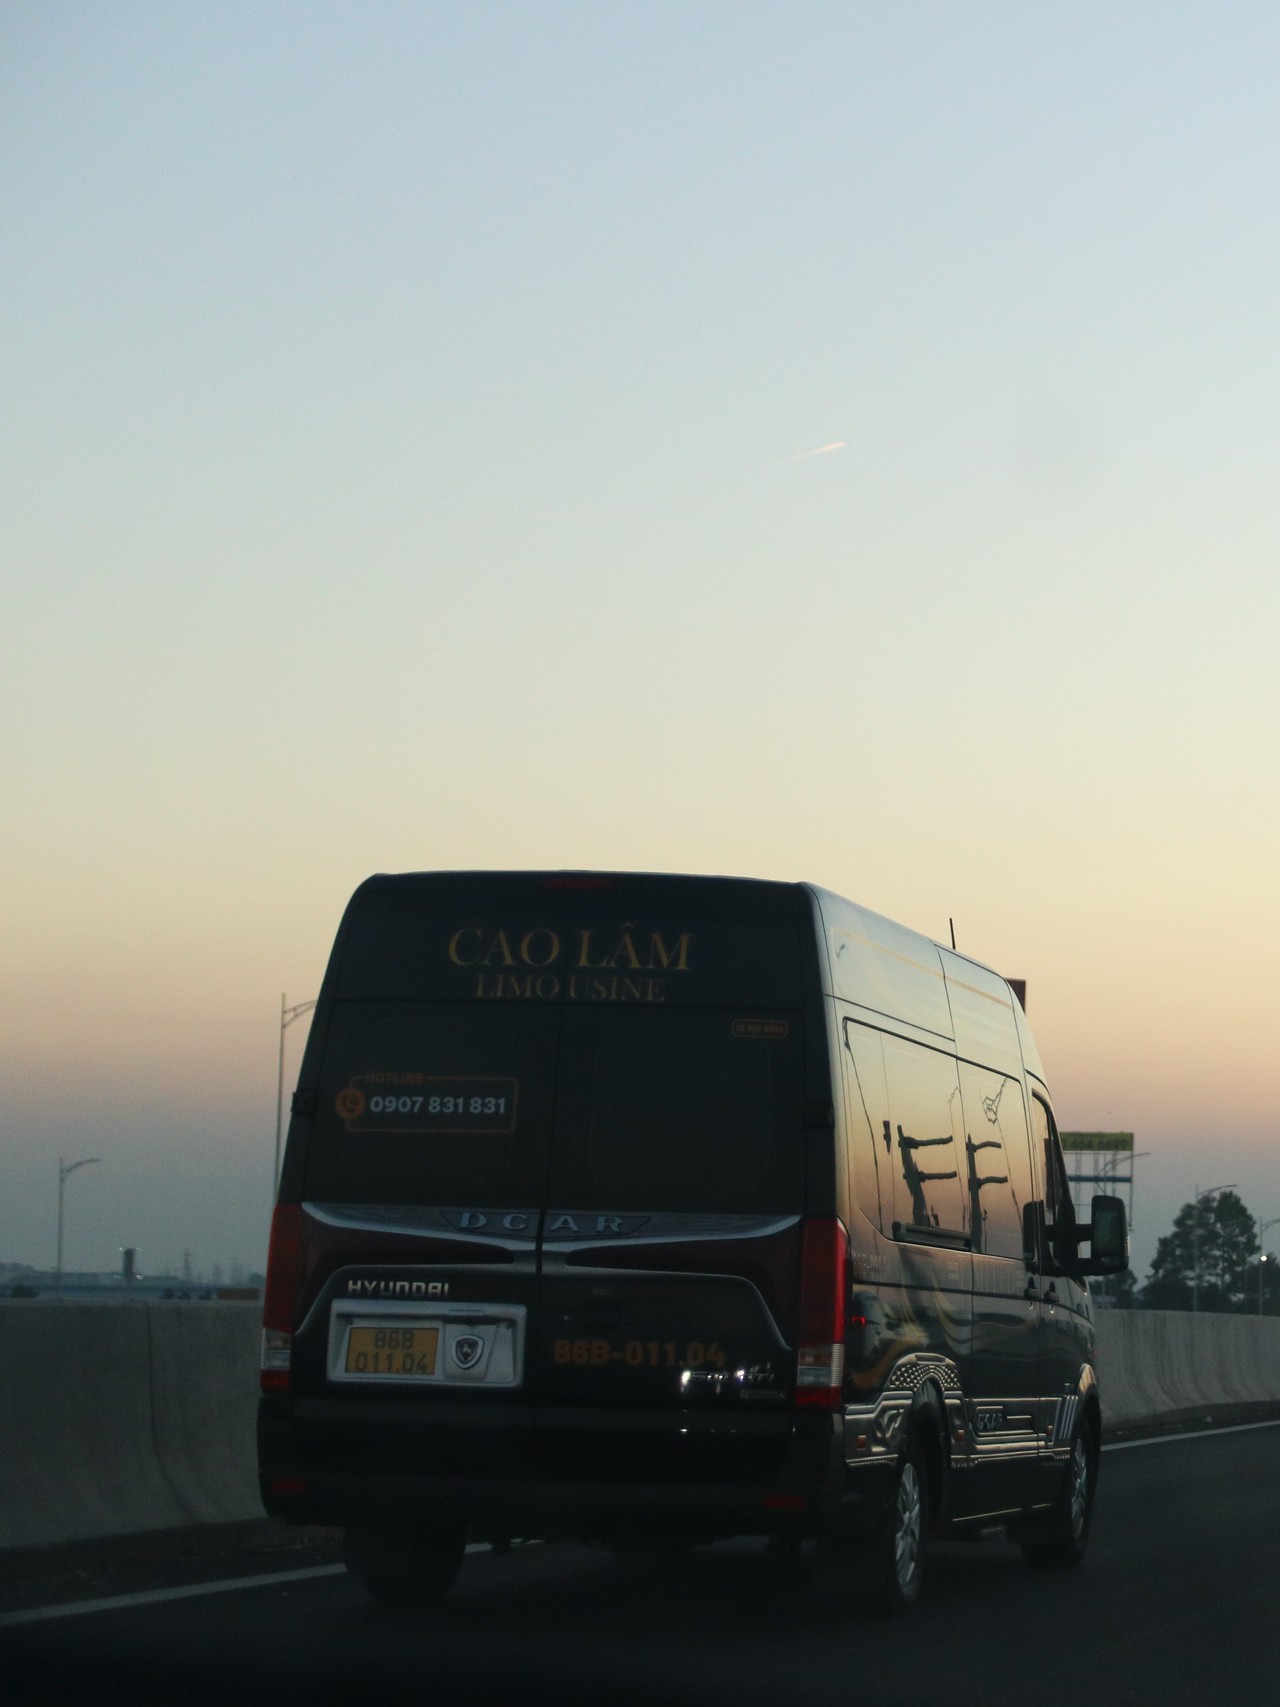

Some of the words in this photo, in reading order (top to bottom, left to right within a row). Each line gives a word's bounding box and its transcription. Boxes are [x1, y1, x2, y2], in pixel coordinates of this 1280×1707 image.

[448, 927, 560, 967] CAO
[576, 920, 693, 971] LÂM
[475, 973, 666, 1002] LIMOUSINE
[365, 1072, 424, 1084] HOTLINE
[370, 1095, 424, 1113] 0907
[427, 1096, 464, 1114] 831
[469, 1097, 507, 1115] 831
[459, 1212, 625, 1232] DCAR
[347, 1279, 450, 1298] HYUNDAI
[374, 1330, 415, 1350] 86B
[354, 1352, 428, 1373] 011.04
[553, 1339, 727, 1368] 86B-011.04
